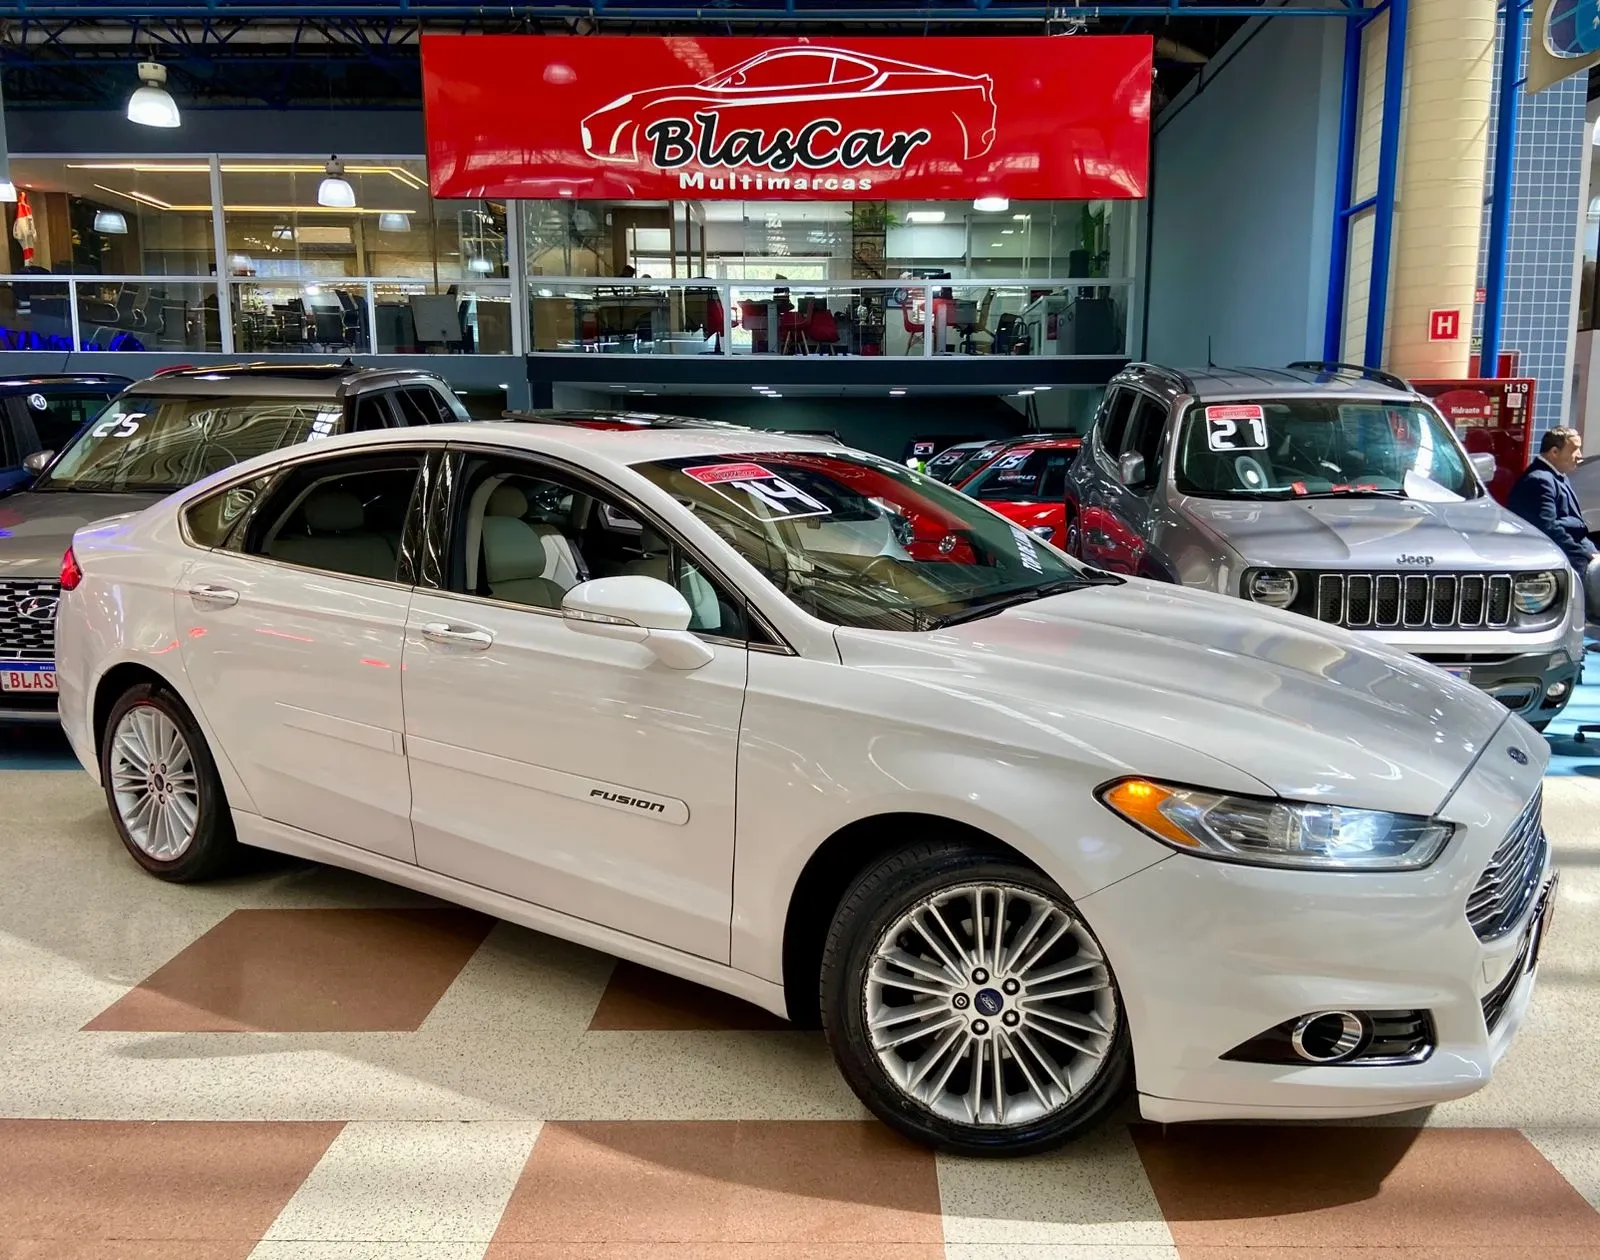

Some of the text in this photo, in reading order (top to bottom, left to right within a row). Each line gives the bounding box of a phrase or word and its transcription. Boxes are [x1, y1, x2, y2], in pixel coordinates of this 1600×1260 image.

[646, 111, 929, 171] BlasCar
[679, 173, 872, 190] Multimarcas
[1437, 316, 1453, 335] H
[1504, 383, 1528, 392] H 19
[1451, 406, 1480, 414] Hidrante
[92, 413, 147, 438] 25
[1211, 419, 1264, 448] 21
[731, 479, 823, 514] 14
[1396, 554, 1434, 567] Jeep
[10, 672, 57, 689] BLAS
[590, 789, 665, 812] FUSION
